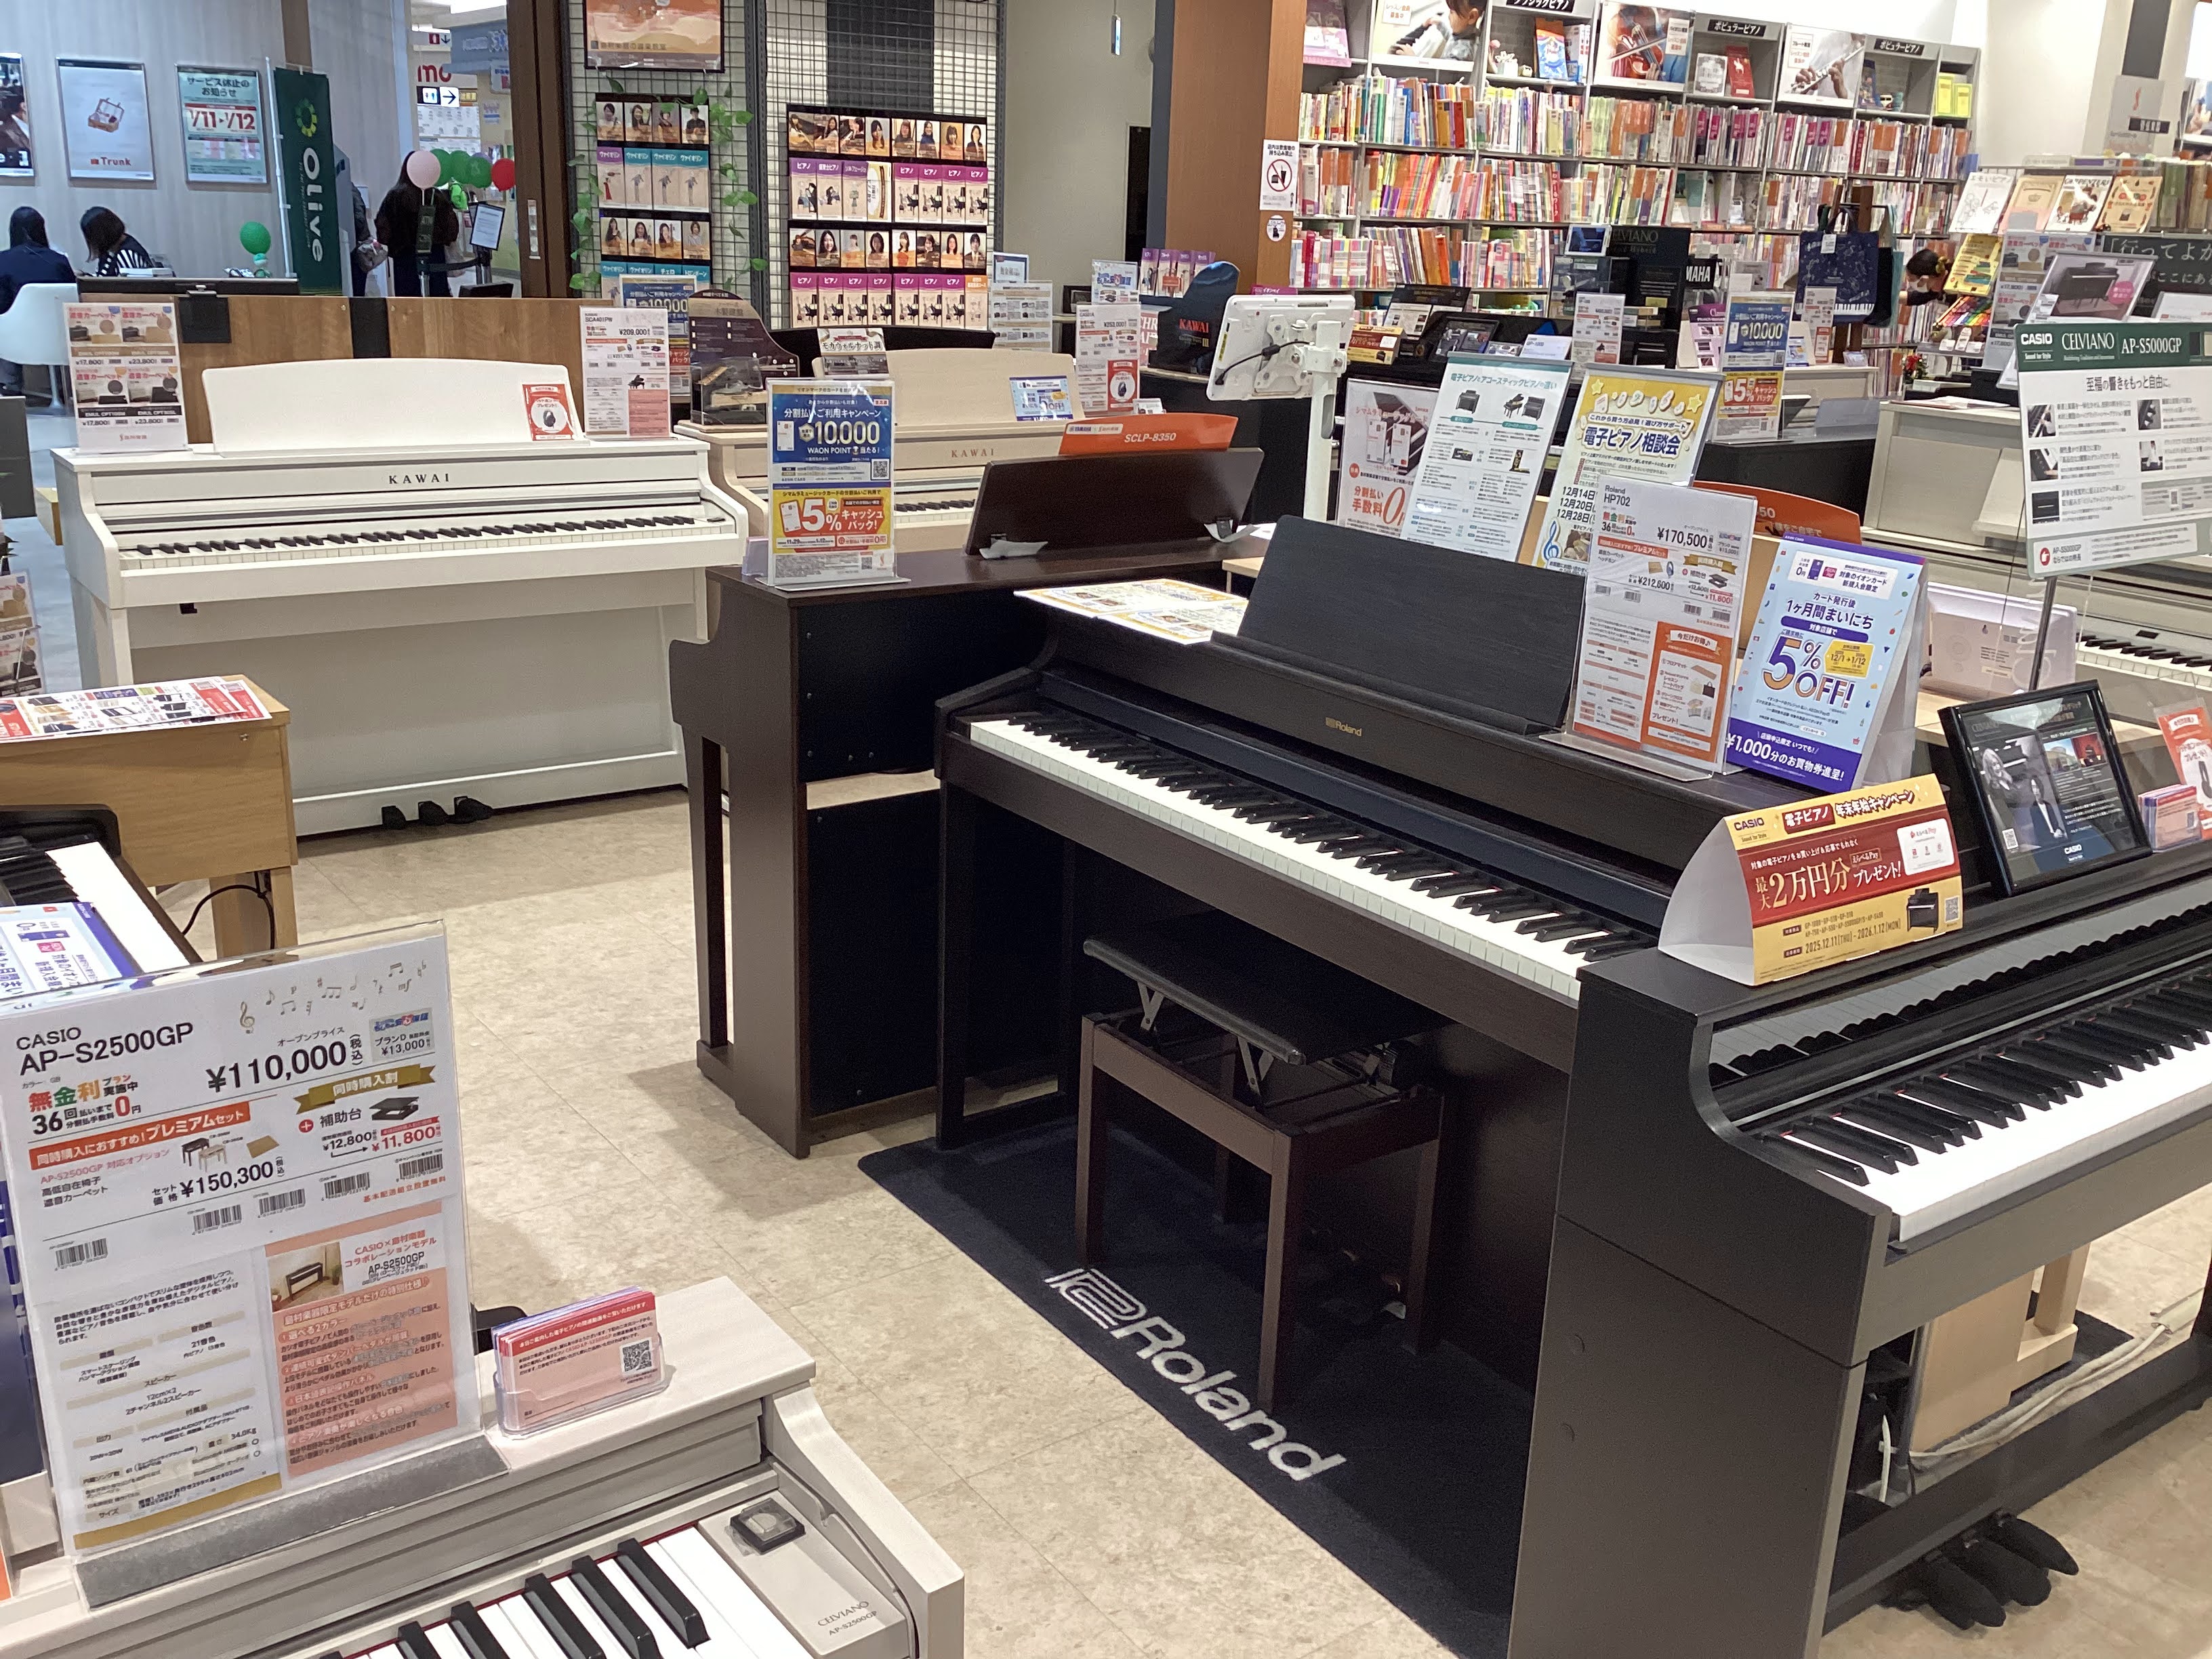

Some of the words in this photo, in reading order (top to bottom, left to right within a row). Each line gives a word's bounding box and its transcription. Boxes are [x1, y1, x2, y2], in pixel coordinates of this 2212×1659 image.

[187, 77, 250, 88] サービス休止の
[201, 87, 237, 98] お知らせ
[100, 157, 131, 167] Trunk
[796, 162, 811, 170] ピアノ
[900, 167, 914, 175] ピアノ
[924, 168, 937, 176] ピアノ
[948, 169, 962, 178] ピアノ
[970, 170, 984, 178] ピアノ
[798, 276, 812, 285] ピアノ
[824, 276, 838, 285] ピアノ
[848, 277, 862, 285] ピアノ
[619, 328, 648, 336] ¥209,000
[1179, 318, 1209, 333] KAWAI
[1748, 322, 1784, 340] 10,000
[2020, 333, 2053, 346] CASIO
[2061, 331, 2115, 351] CELVIANO
[2121, 337, 2182, 355] AP-S5000GP
[1754, 386, 1779, 397] キャッシュ
[1755, 394, 1775, 403] バック!
[1589, 414, 1687, 430] これから買う方必見!選び方サポート
[815, 420, 880, 445] 10,000
[1124, 432, 1177, 443] SCLP-8350
[1584, 426, 1682, 456] 電子ピアノ相談会
[807, 447, 830, 455] WAON
[830, 447, 852, 455] POINT
[950, 447, 995, 458] KAWAI
[388, 473, 451, 485] KAWAI
[1354, 485, 1384, 499] 分割払い
[1605, 485, 1626, 495] Roland
[1352, 497, 1384, 518] 手数料
[1603, 493, 1631, 508] HP702
[802, 497, 842, 533] 5%
[841, 509, 884, 520] キャッシュ
[848, 520, 878, 531] バック!
[1601, 520, 1612, 533] 36
[1657, 526, 1708, 549] ¥170,500
[1637, 575, 1671, 591] ¥212,600
[1839, 570, 1888, 586] 対象のイオンカード
[1842, 579, 1879, 593] 新規入会限定
[1813, 592, 1857, 609] カード発行後
[1786, 599, 1875, 630] 1ヶ月間まいにち
[1763, 633, 1823, 691] 5%
[1795, 670, 1856, 709] OFF!
[1651, 712, 1679, 725] プレゼント!
[1335, 720, 1362, 737] Roland
[1784, 806, 1830, 827] 電子ピアノ
[1835, 790, 1915, 818] 年末年始キャンペーン
[1734, 817, 1765, 832] CASIO
[1851, 850, 1881, 864] えらべるPay
[2064, 844, 2083, 856] CASIO
[1853, 860, 1902, 888] プレゼント!
[1769, 856, 1852, 909] 2万円分
[1805, 931, 1853, 955] 2025.12.11[THU]
[1857, 917, 1902, 940] 2026.1.12[MON]
[16, 1027, 81, 1050] CASIO
[277, 1026, 346, 1047] オープンプライス
[374, 1033, 406, 1046] プランD
[20, 1022, 194, 1076] AP-S2500GP
[381, 1039, 426, 1056] ¥13,000
[206, 1040, 347, 1093] ¥110,000
[102, 1074, 131, 1086] プラン
[28, 1079, 101, 1113] 無金利
[103, 1081, 139, 1097] 実施中
[114, 1095, 131, 1118] 0
[131, 1104, 142, 1115] 円
[32, 1111, 64, 1136] 36
[319, 1108, 362, 1128] 補助台
[323, 1131, 373, 1151] ¥12,800
[372, 1126, 436, 1152] ¥11,800
[180, 1160, 274, 1198] ¥150,300
[152, 1184, 178, 1196] セット
[1110, 1316, 1347, 1481] Roland
[817, 1601, 869, 1628] CELVIANO
[829, 1610, 878, 1637] AP-S2500GP
